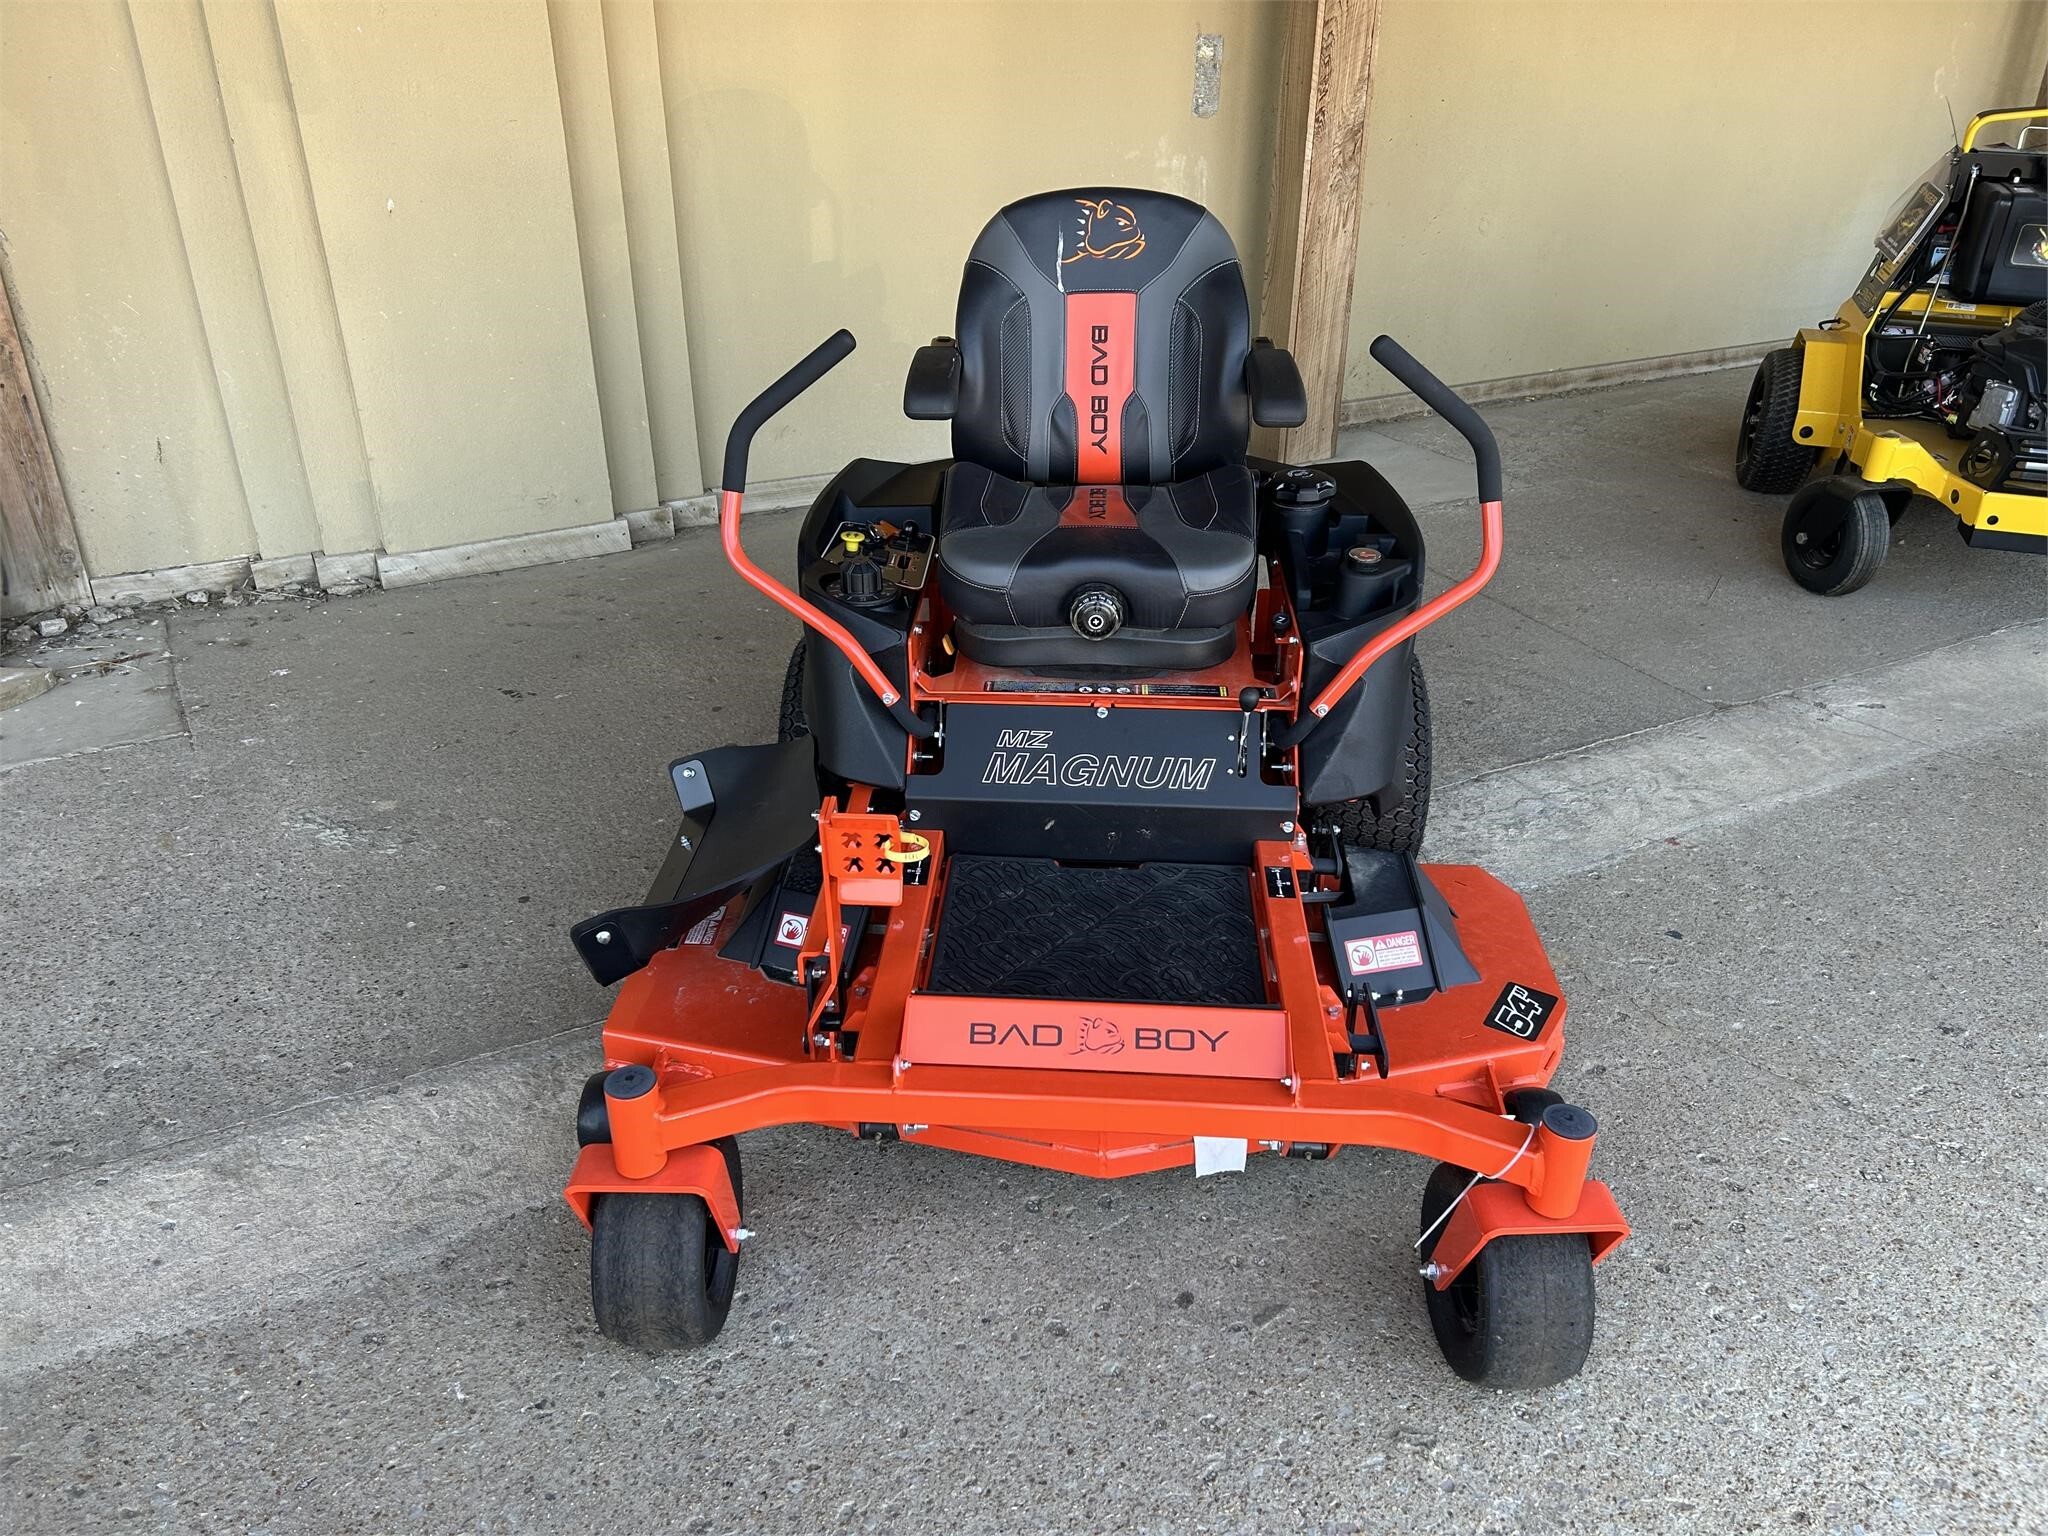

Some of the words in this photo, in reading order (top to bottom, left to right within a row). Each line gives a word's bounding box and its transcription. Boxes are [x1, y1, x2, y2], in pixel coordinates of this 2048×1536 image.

[1091, 325, 1109, 386] BAD
[1091, 395, 1109, 455] BOY
[996, 729, 1053, 749] MZ
[982, 752, 1216, 790] MAGNUM
[1386, 935, 1416, 948] DANGER
[968, 1022, 1063, 1047] BAD
[1135, 1027, 1230, 1053] BOY
